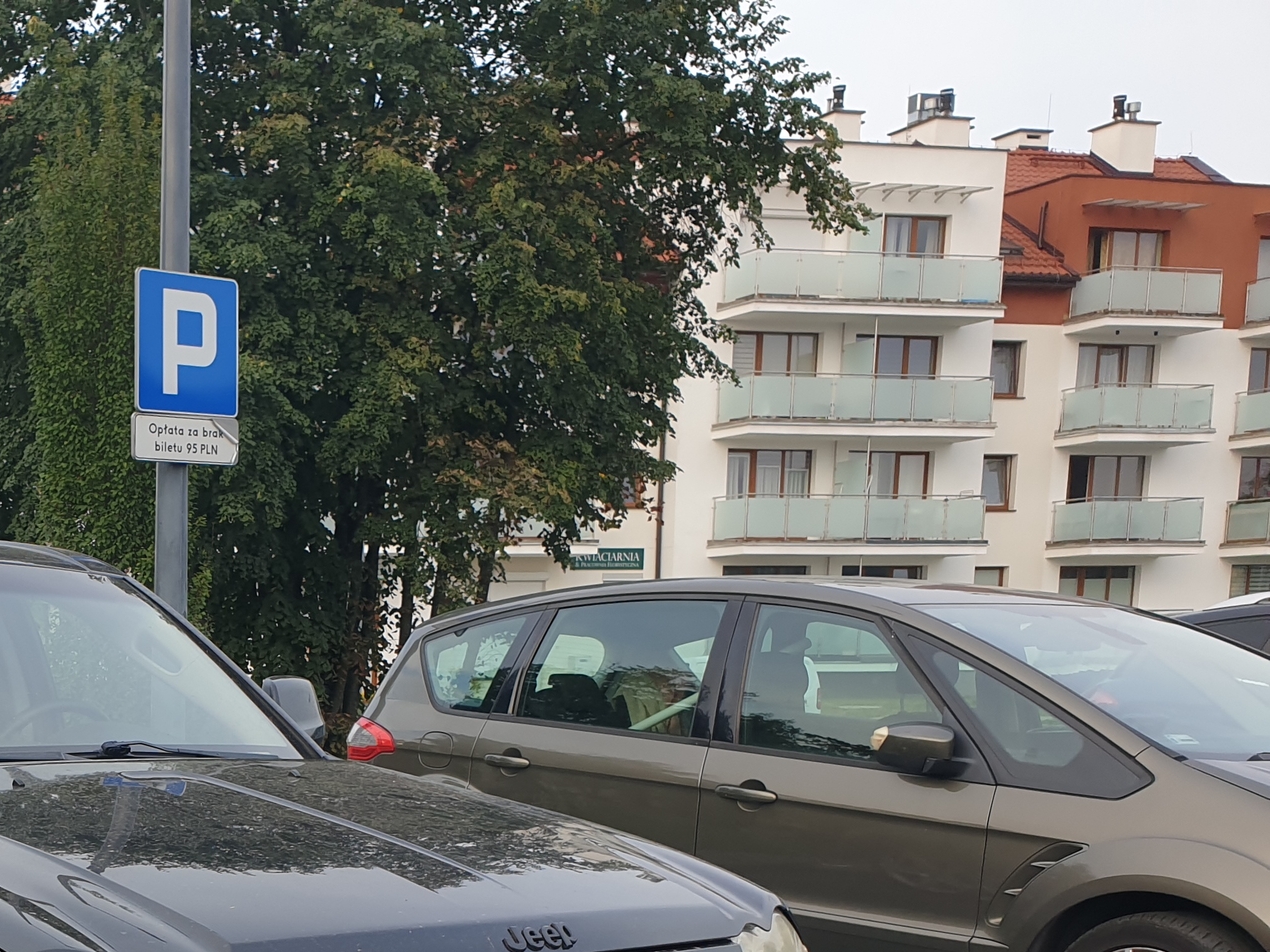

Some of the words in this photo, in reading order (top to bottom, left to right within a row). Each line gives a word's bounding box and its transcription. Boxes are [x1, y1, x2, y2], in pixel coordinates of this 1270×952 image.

[162, 287, 218, 396] P
[148, 422, 184, 438] Opłata
[187, 428, 199, 437] za
[202, 426, 224, 439] brak
[154, 440, 183, 453] biletu
[186, 442, 198, 454] 95
[200, 443, 218, 455] PLN
